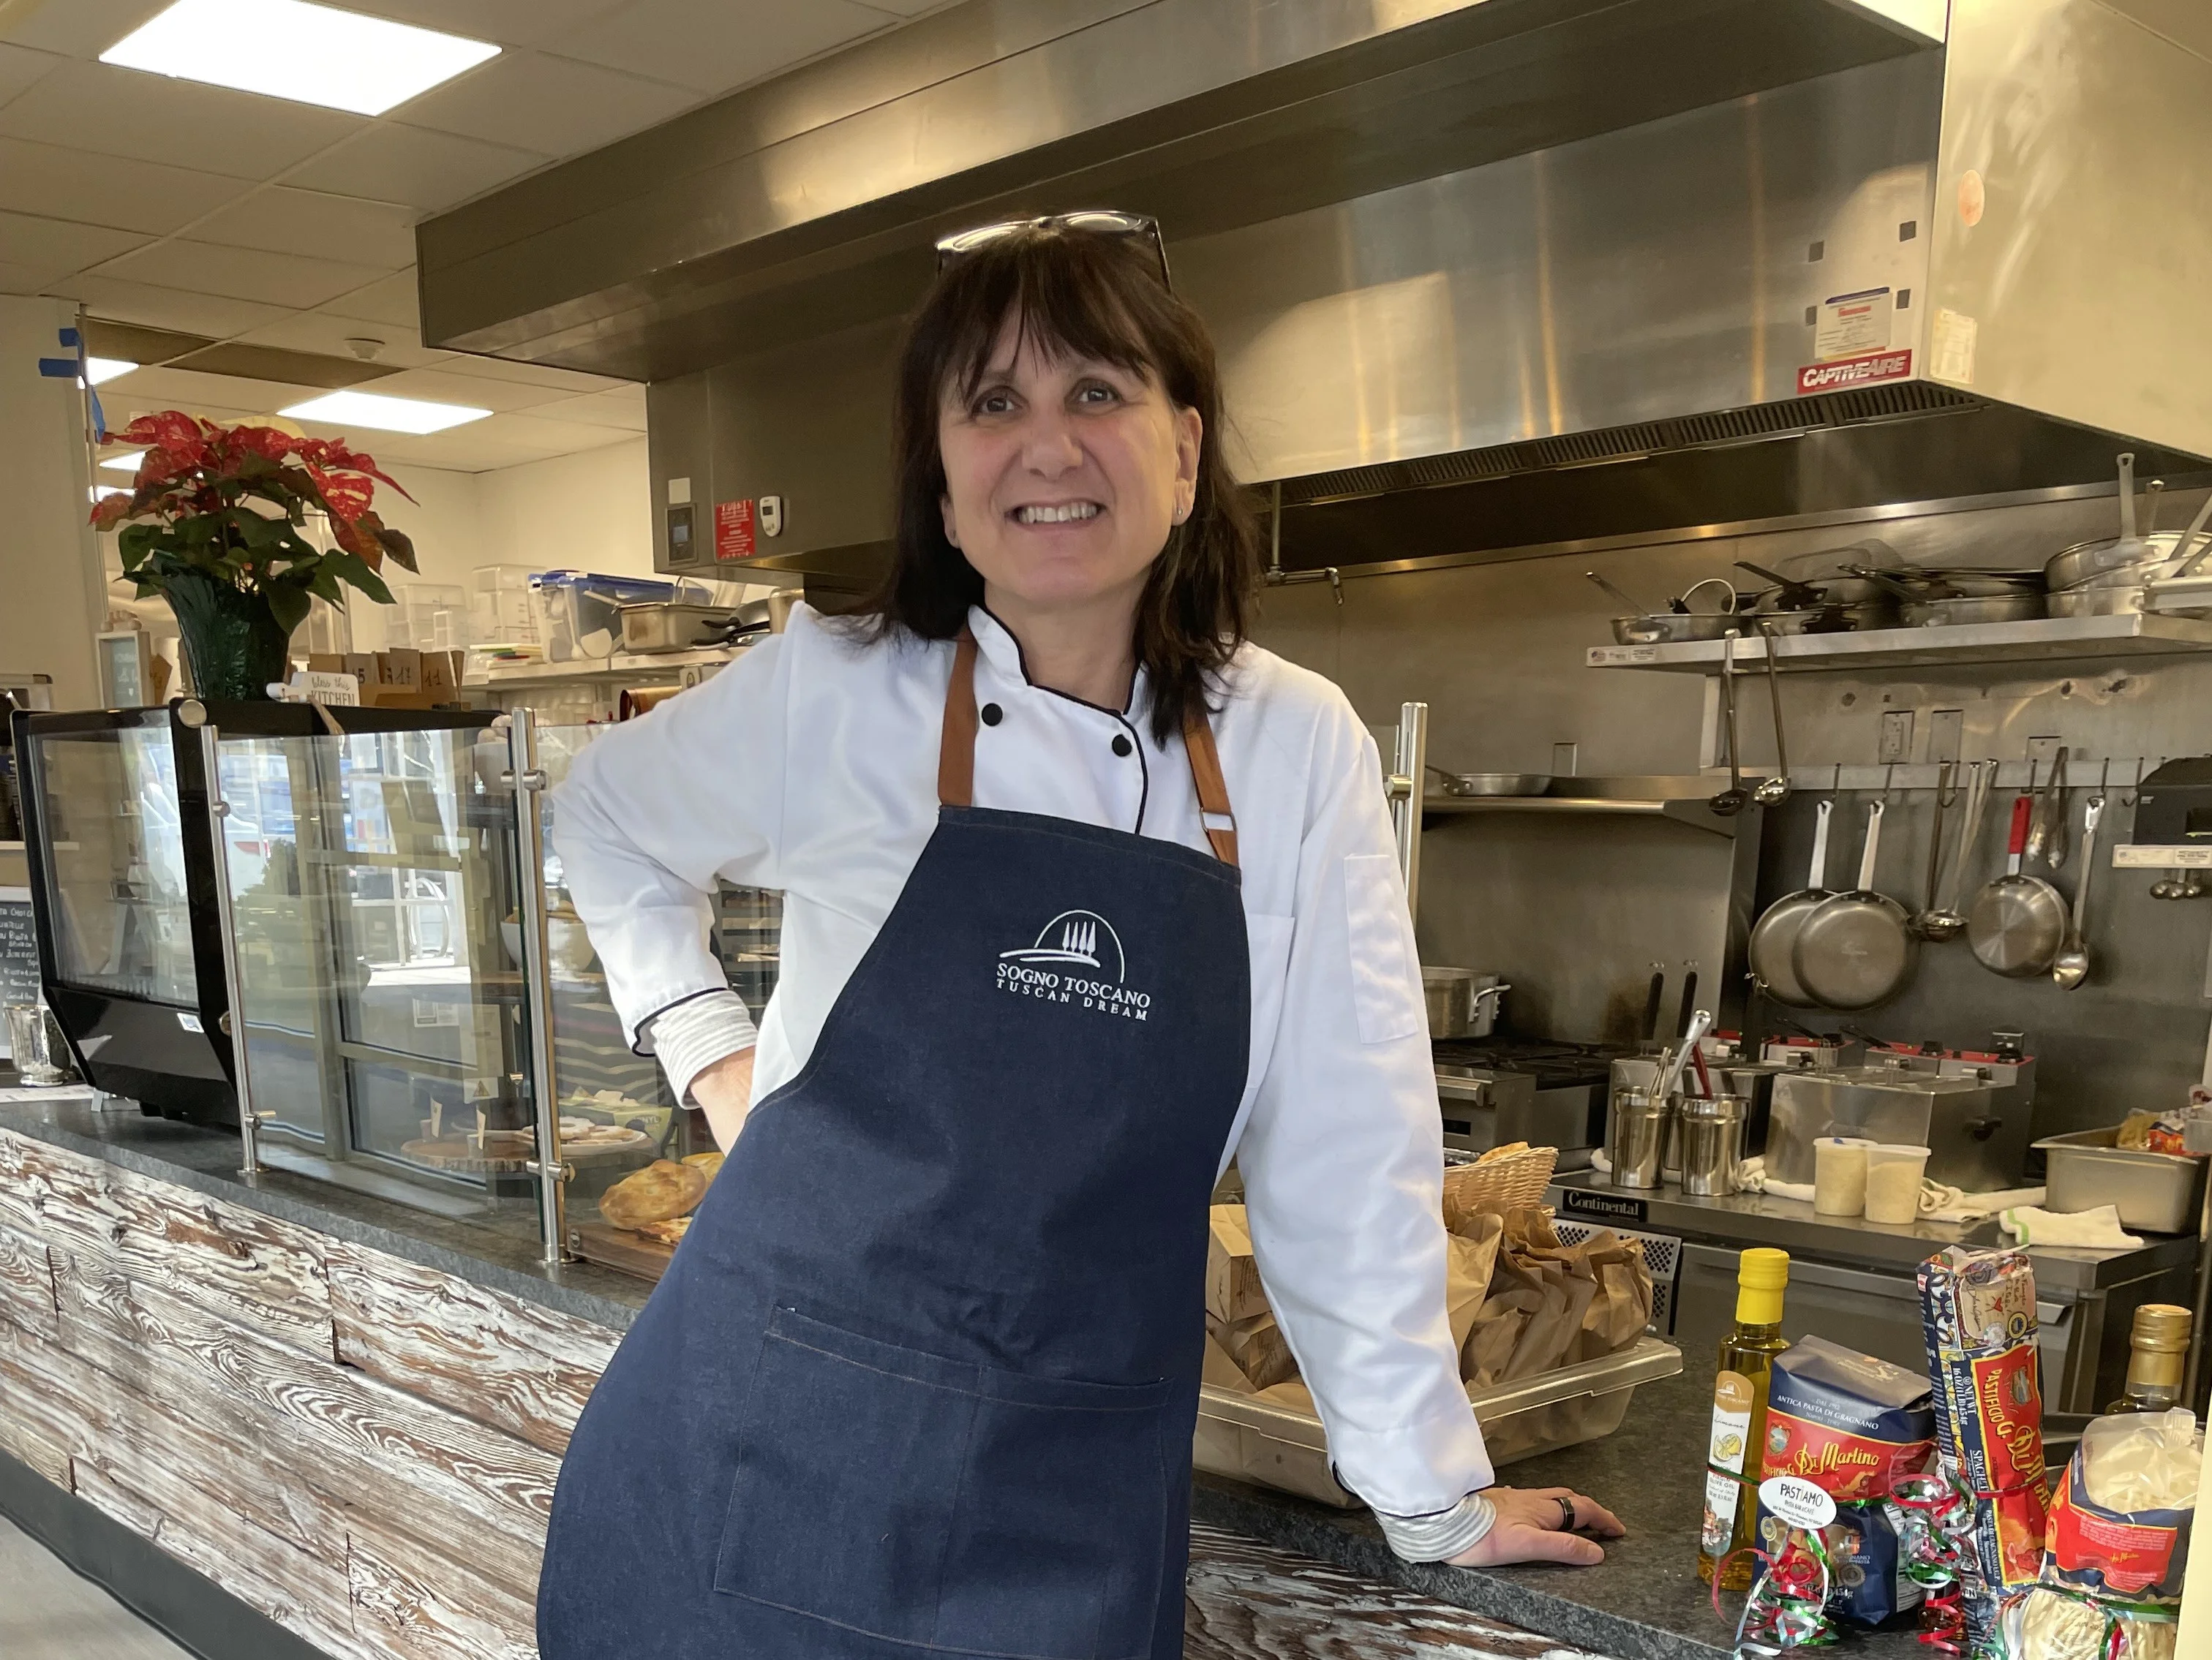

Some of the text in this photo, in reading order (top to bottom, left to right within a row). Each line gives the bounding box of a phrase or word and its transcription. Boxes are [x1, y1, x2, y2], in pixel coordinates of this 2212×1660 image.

[312, 676, 351, 691] bless this
[996, 962, 1151, 1008] SOGNO TOSCANO
[996, 978, 1148, 1022] TUSCAN DREAM
[1568, 1191, 1639, 1215] Continental
[1778, 1395, 1879, 1430] ANTICA PASTA DI GRAGNANO
[1983, 1368, 2005, 1423] PASTIFICIO
[1813, 1441, 1881, 1474] Martino
